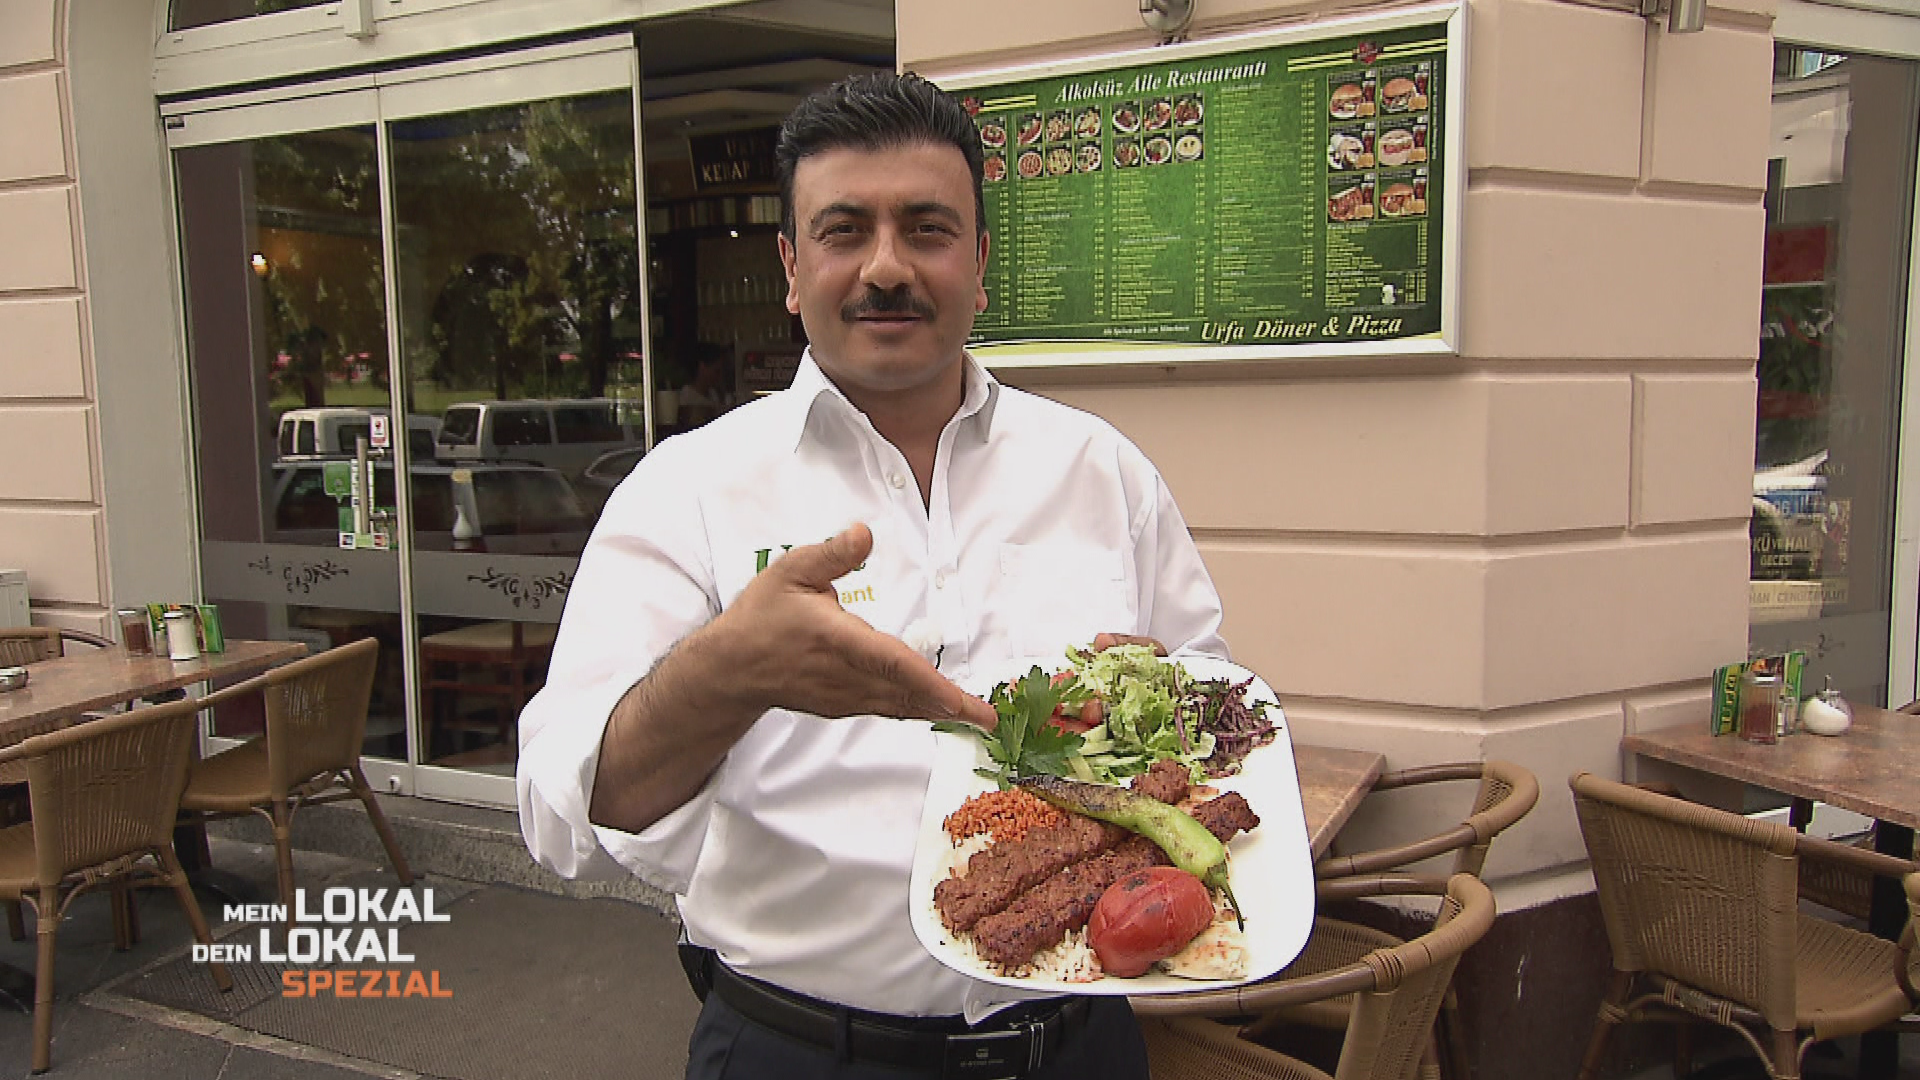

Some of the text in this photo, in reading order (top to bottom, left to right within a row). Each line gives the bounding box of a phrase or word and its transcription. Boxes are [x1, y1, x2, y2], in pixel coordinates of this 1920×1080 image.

[1201, 314, 1403, 344] Urfa Döner & Pizza
